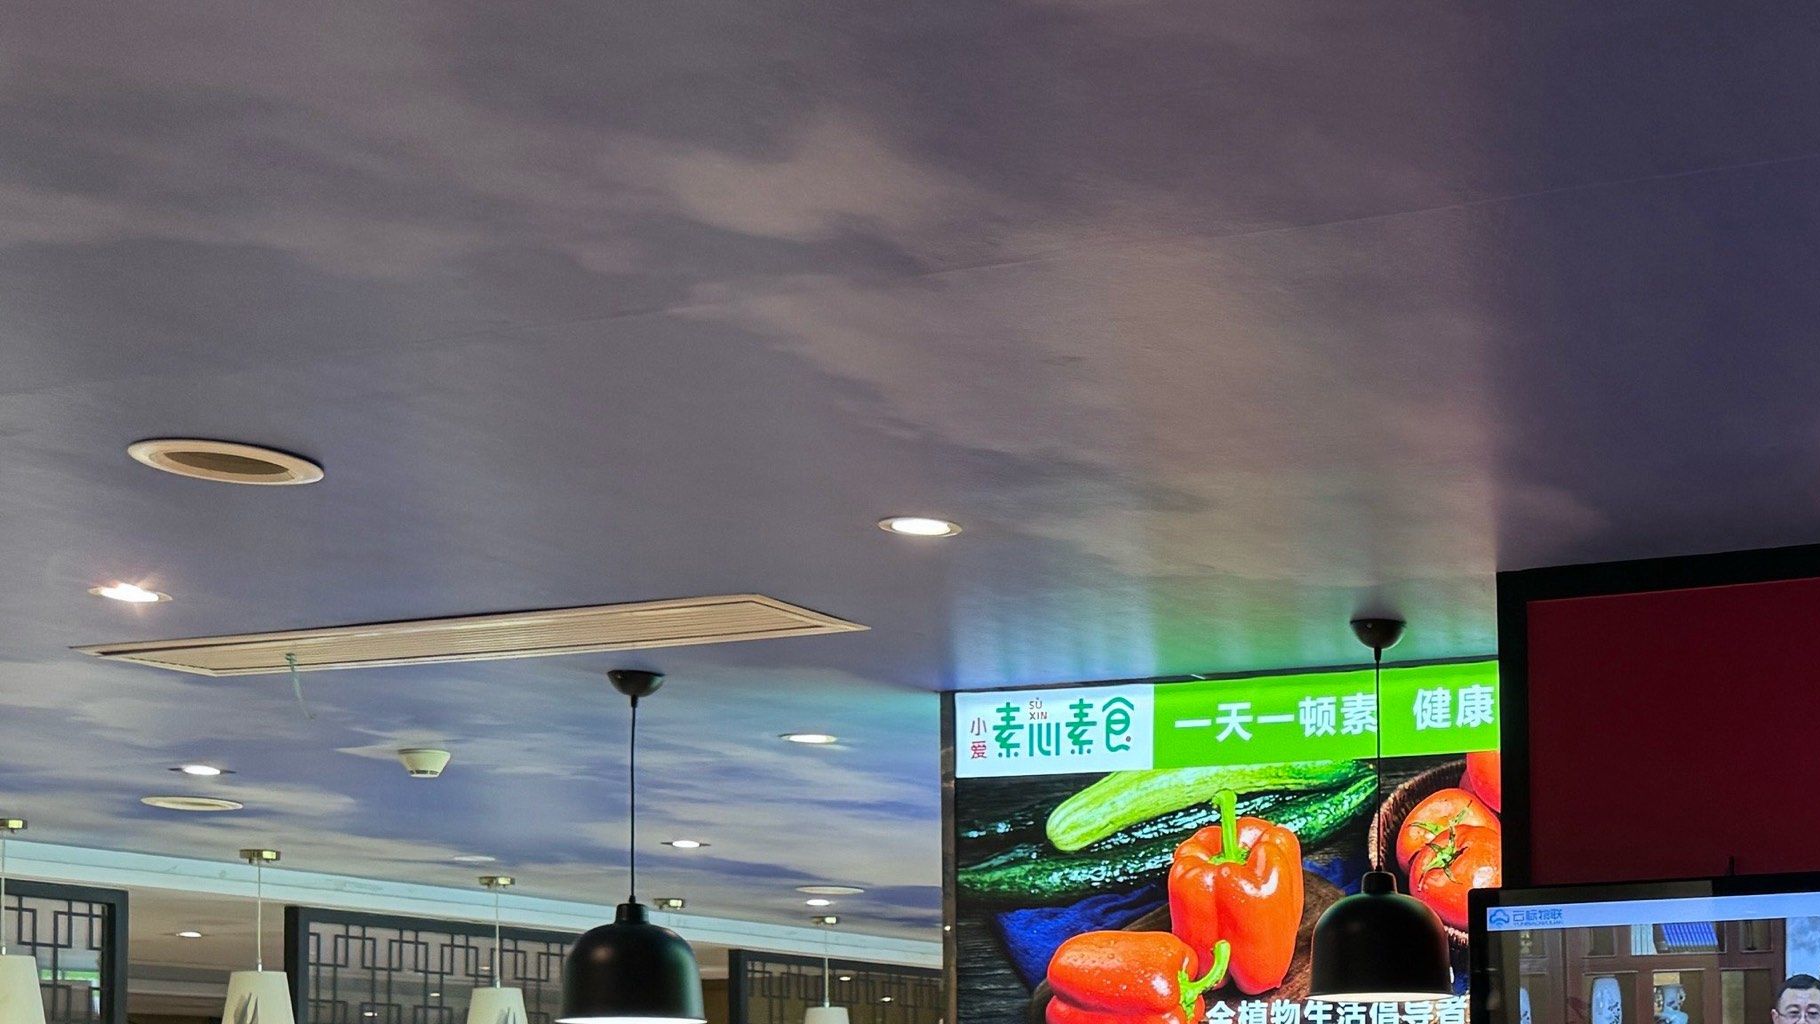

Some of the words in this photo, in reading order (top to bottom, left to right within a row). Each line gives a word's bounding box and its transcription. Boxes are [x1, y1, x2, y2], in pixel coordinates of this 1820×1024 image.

[971, 717, 987, 759] 小爱
[992, 696, 1135, 758] 素心素食
[1175, 692, 1377, 742] 一天一顿素
[1413, 684, 1495, 730] 健康
